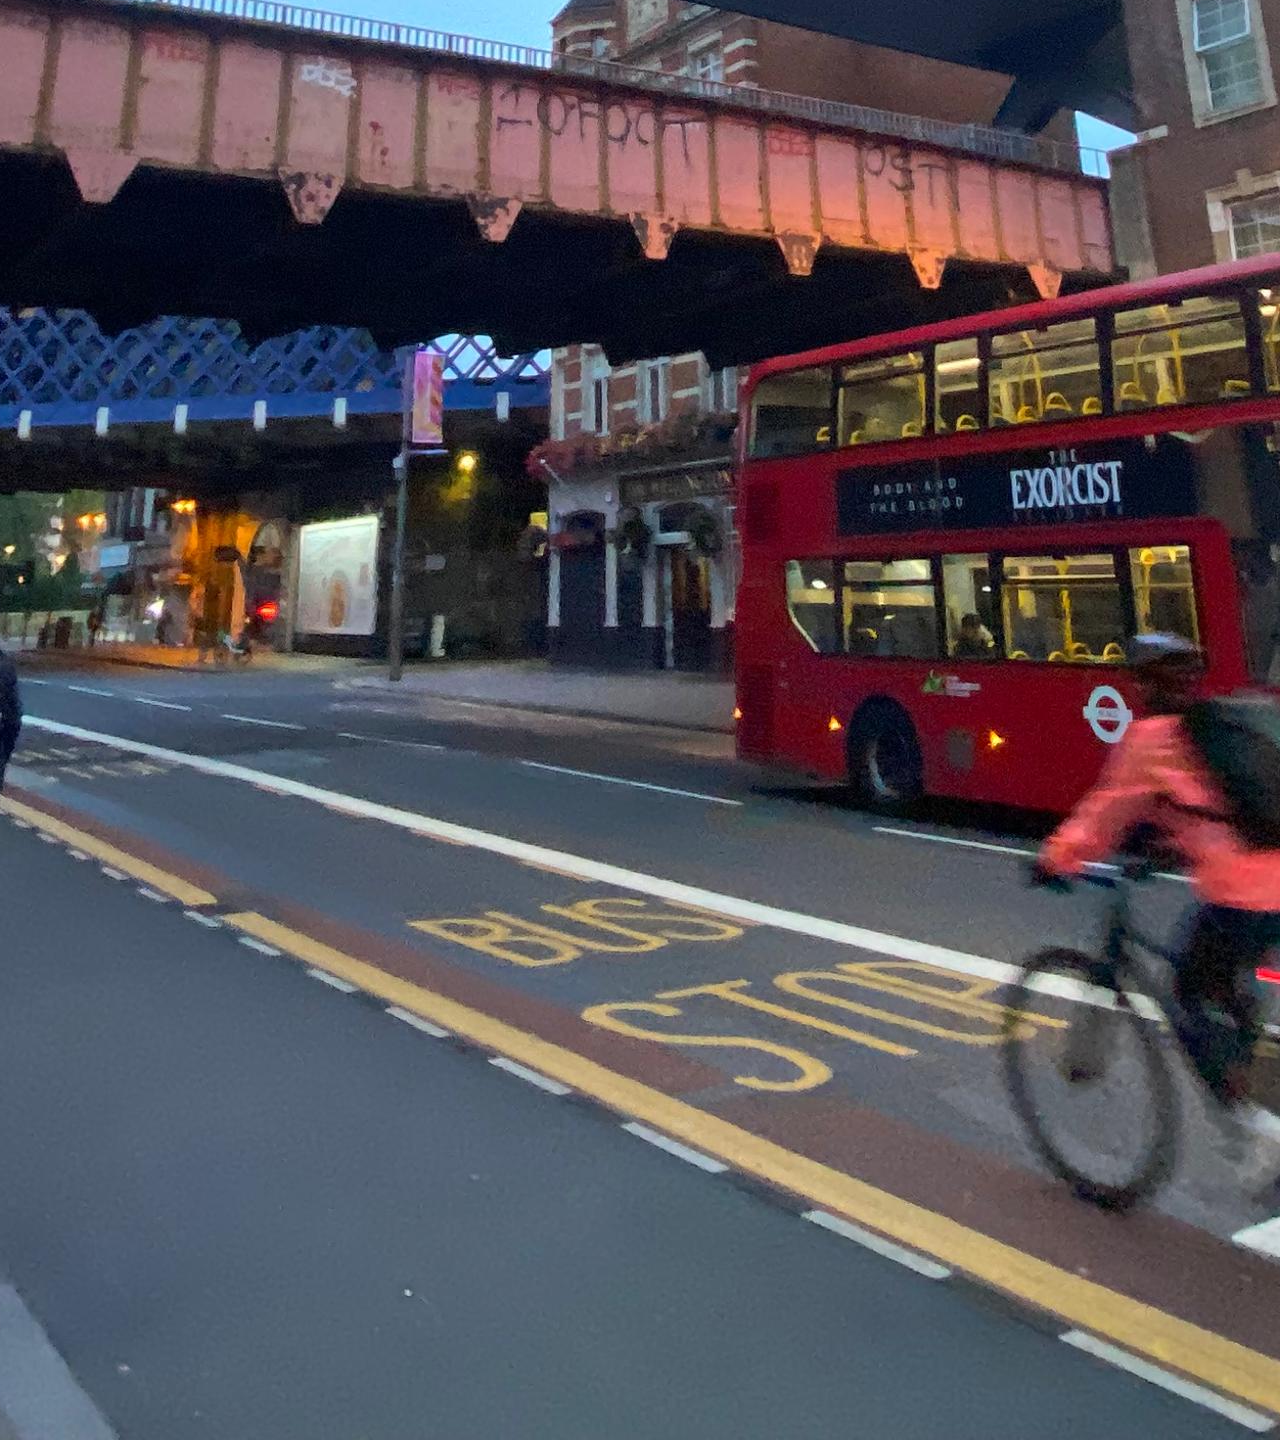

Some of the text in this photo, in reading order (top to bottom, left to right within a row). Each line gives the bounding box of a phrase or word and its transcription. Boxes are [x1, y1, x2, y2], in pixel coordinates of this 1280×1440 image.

[1010, 460, 1122, 510] EXORCIST
[407, 898, 744, 968] BUS
[581, 959, 1070, 1093] STOP
